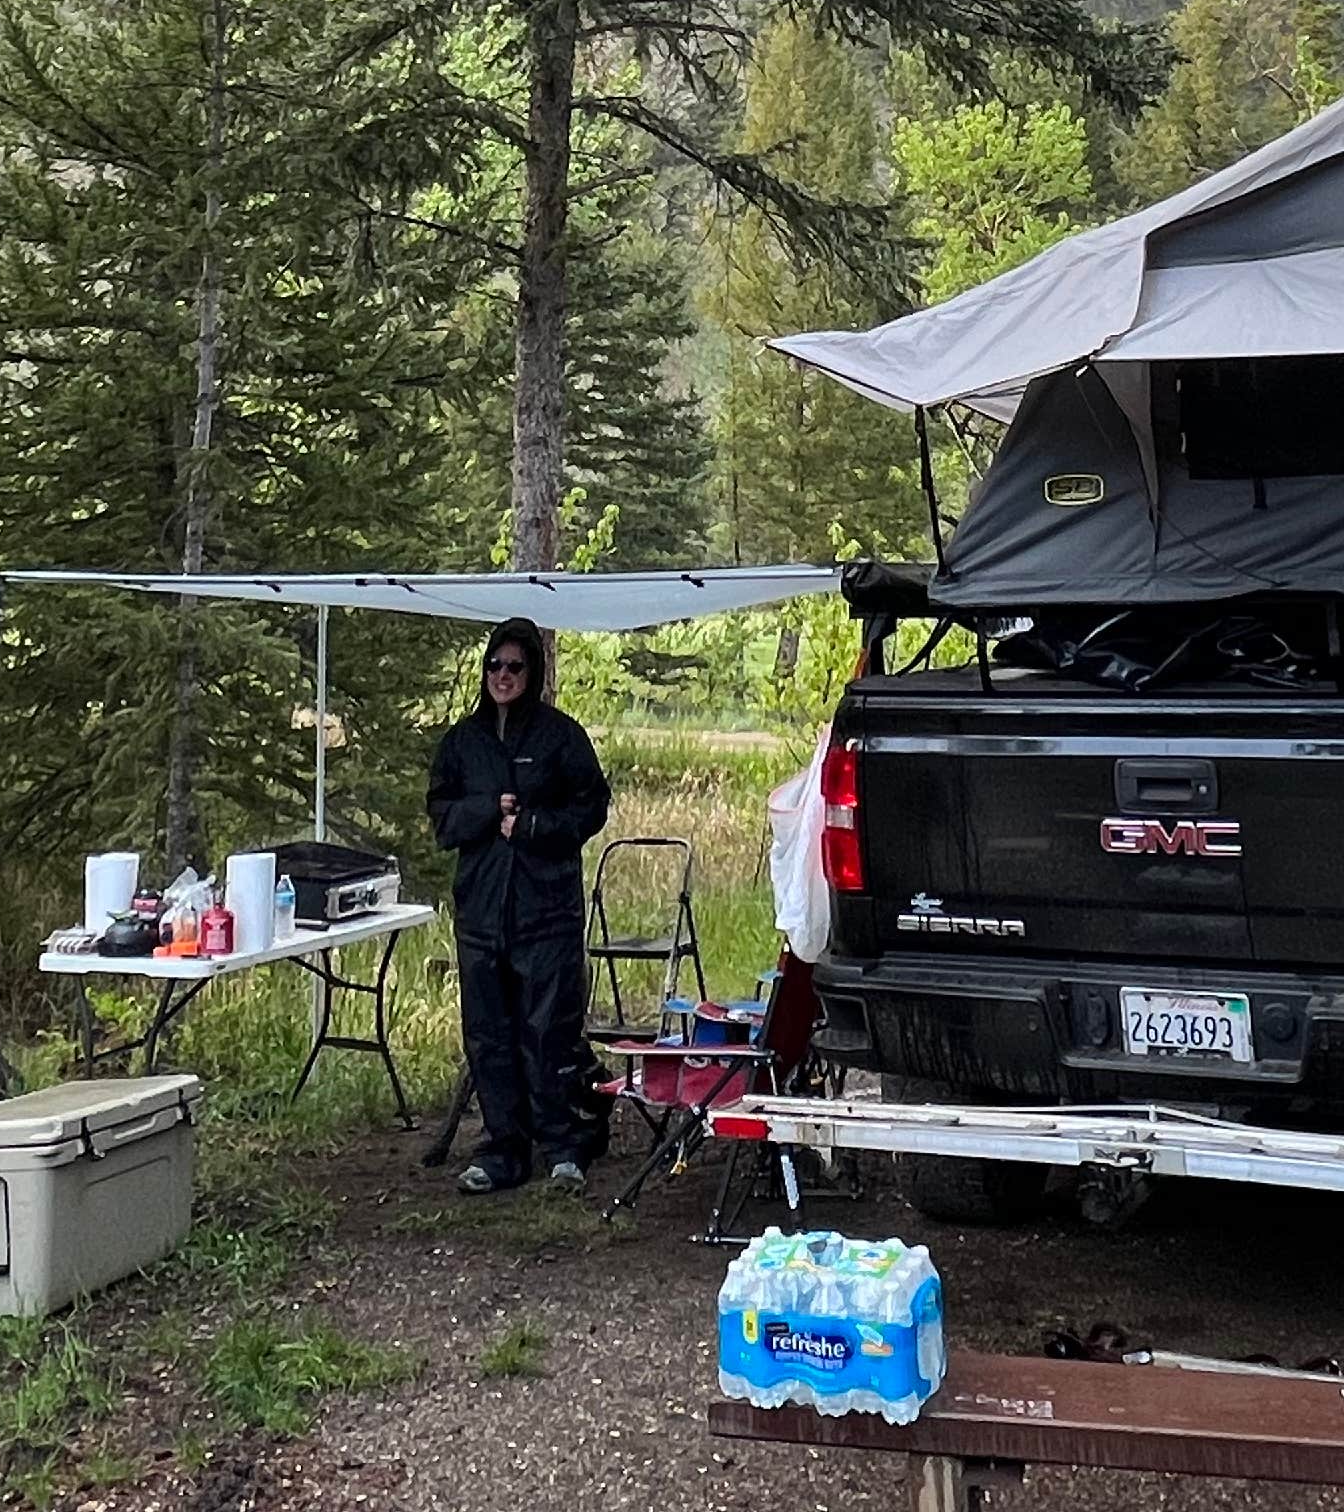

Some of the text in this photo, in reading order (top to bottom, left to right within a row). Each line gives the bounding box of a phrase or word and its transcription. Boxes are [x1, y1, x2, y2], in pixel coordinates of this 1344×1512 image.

[1100, 818, 1242, 856] GMC
[896, 914, 1026, 937] SIERRA
[1130, 1011, 1233, 1048] 2623693
[772, 1333, 846, 1358] refreshe
